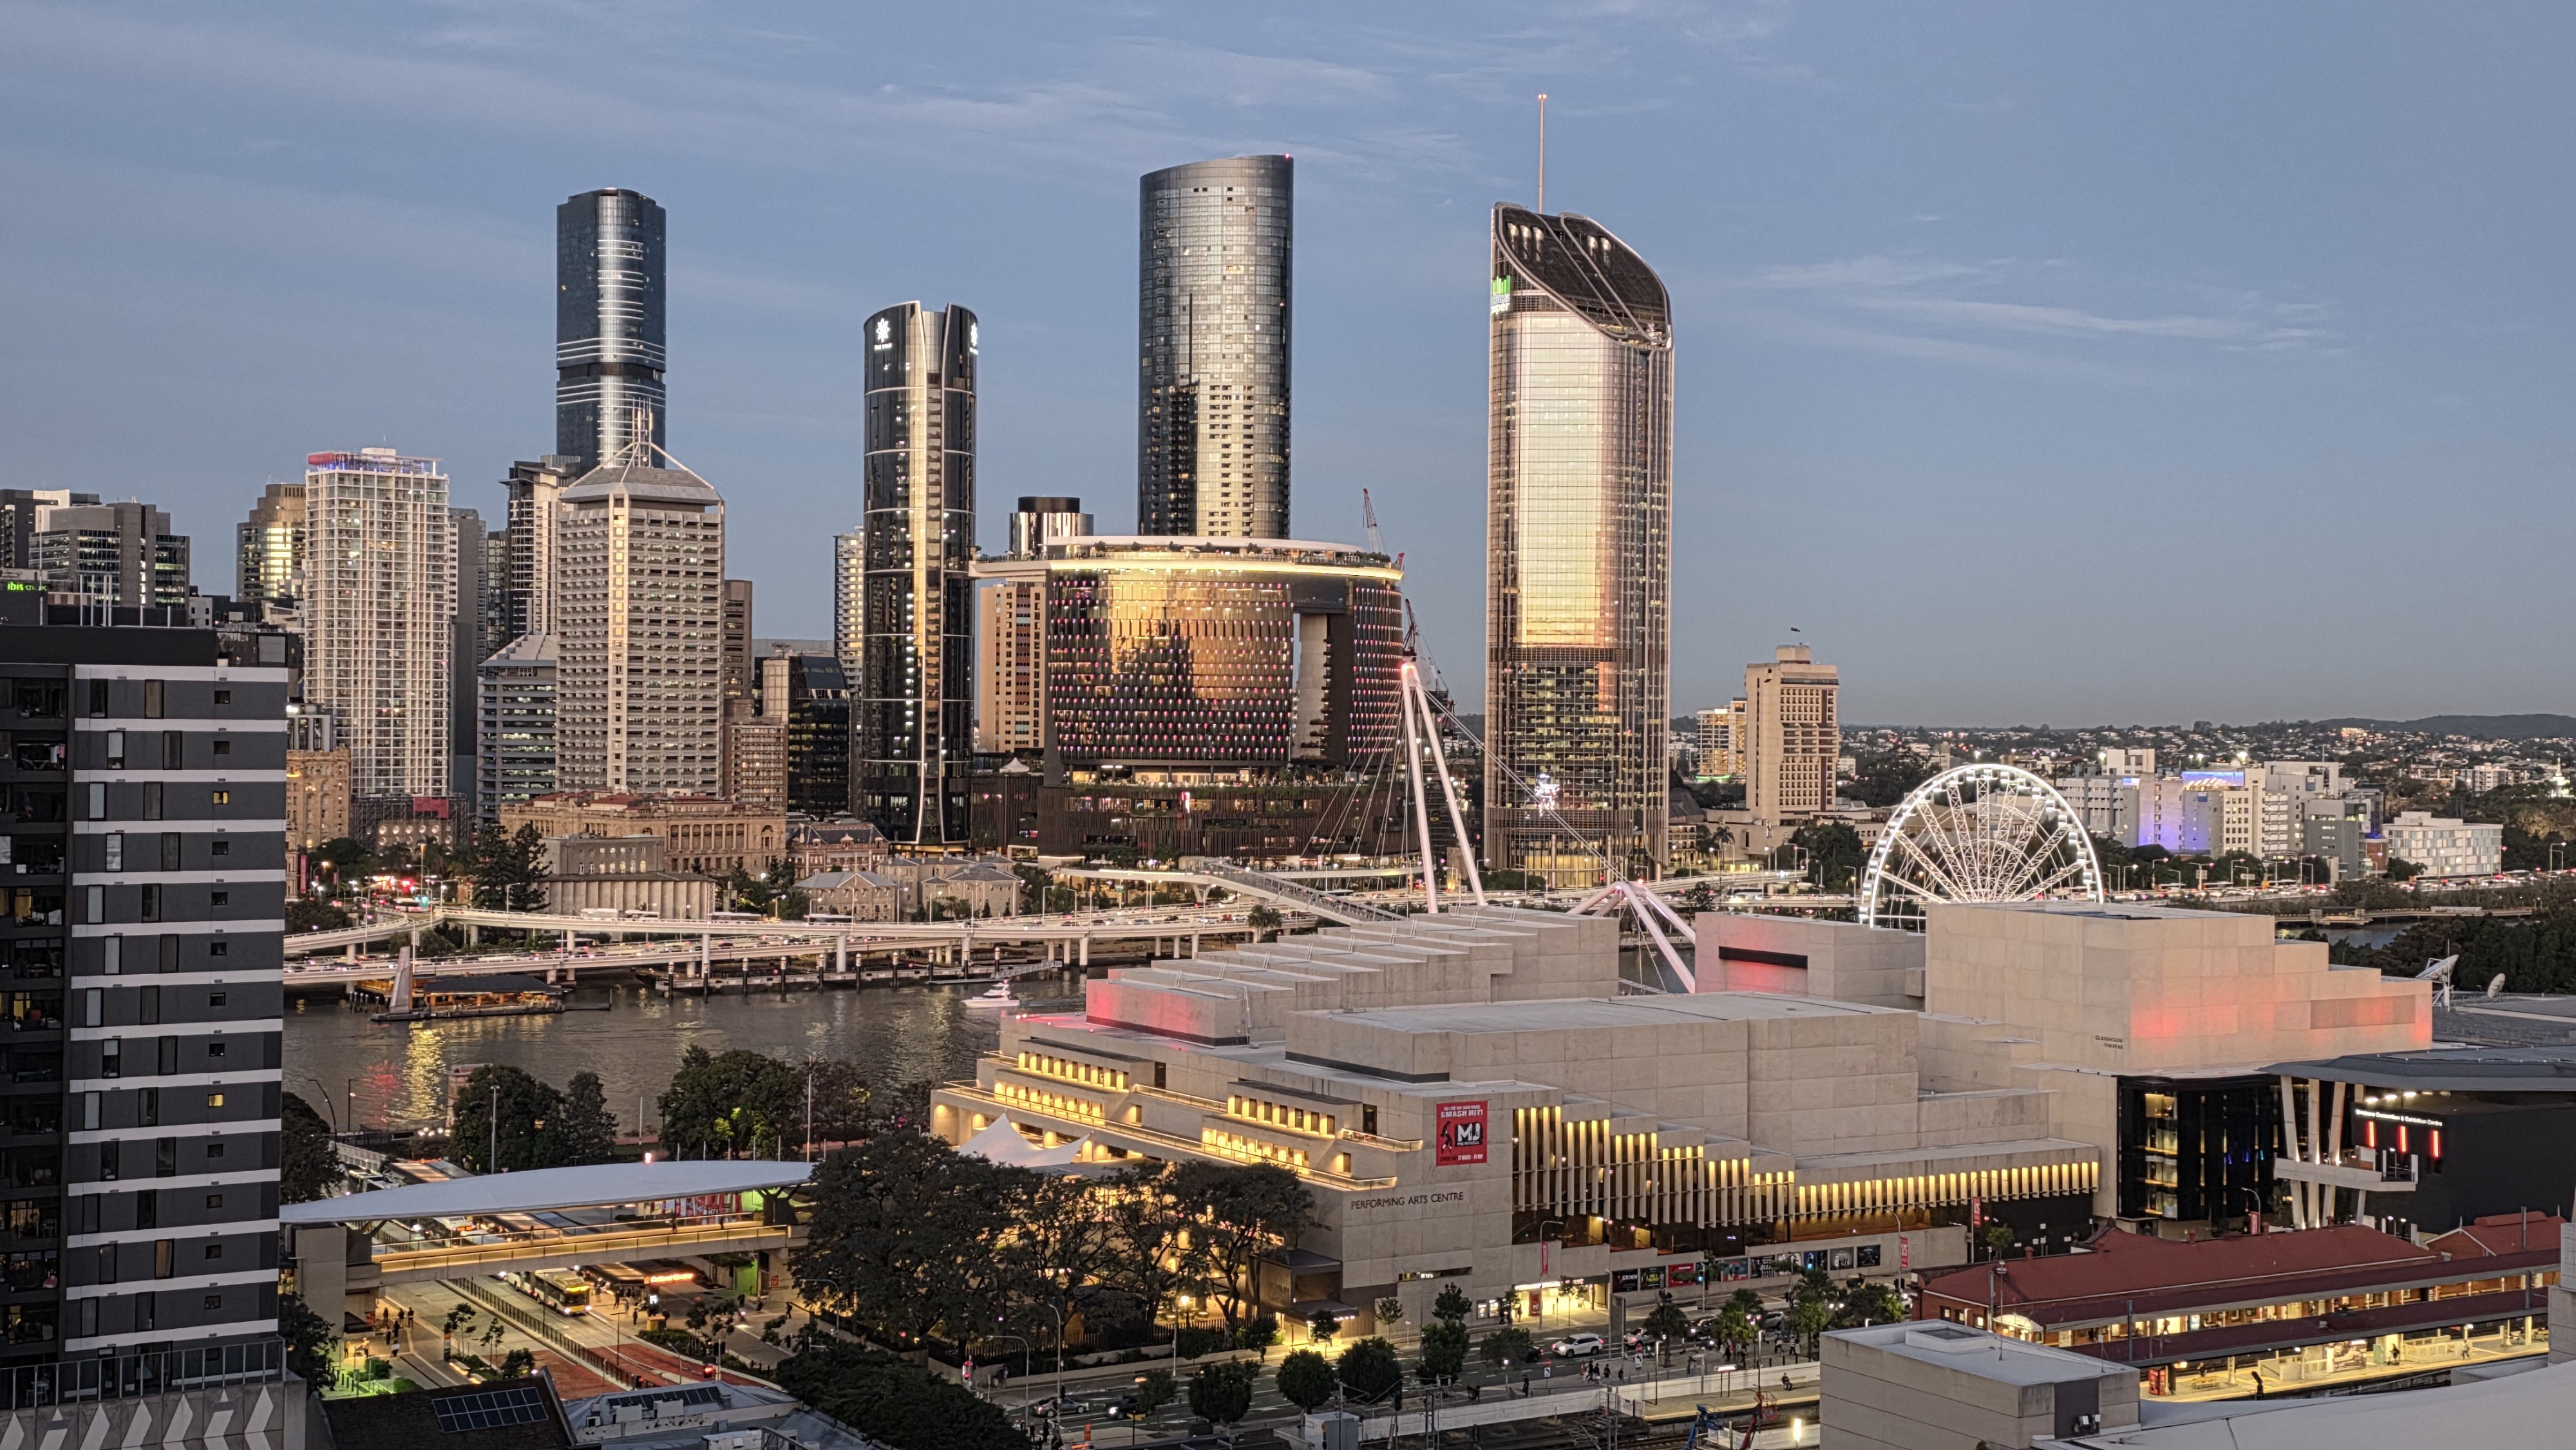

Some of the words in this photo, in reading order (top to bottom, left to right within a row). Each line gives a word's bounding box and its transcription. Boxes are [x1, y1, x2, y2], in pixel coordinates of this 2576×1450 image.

[8, 581, 24, 590] ibis
[1457, 1123, 1481, 1142] MJ
[1351, 1197, 1405, 1210] PERFORMING
[1408, 1195, 1428, 1205] ARTS
[1431, 1192, 1464, 1202] CENTRE
